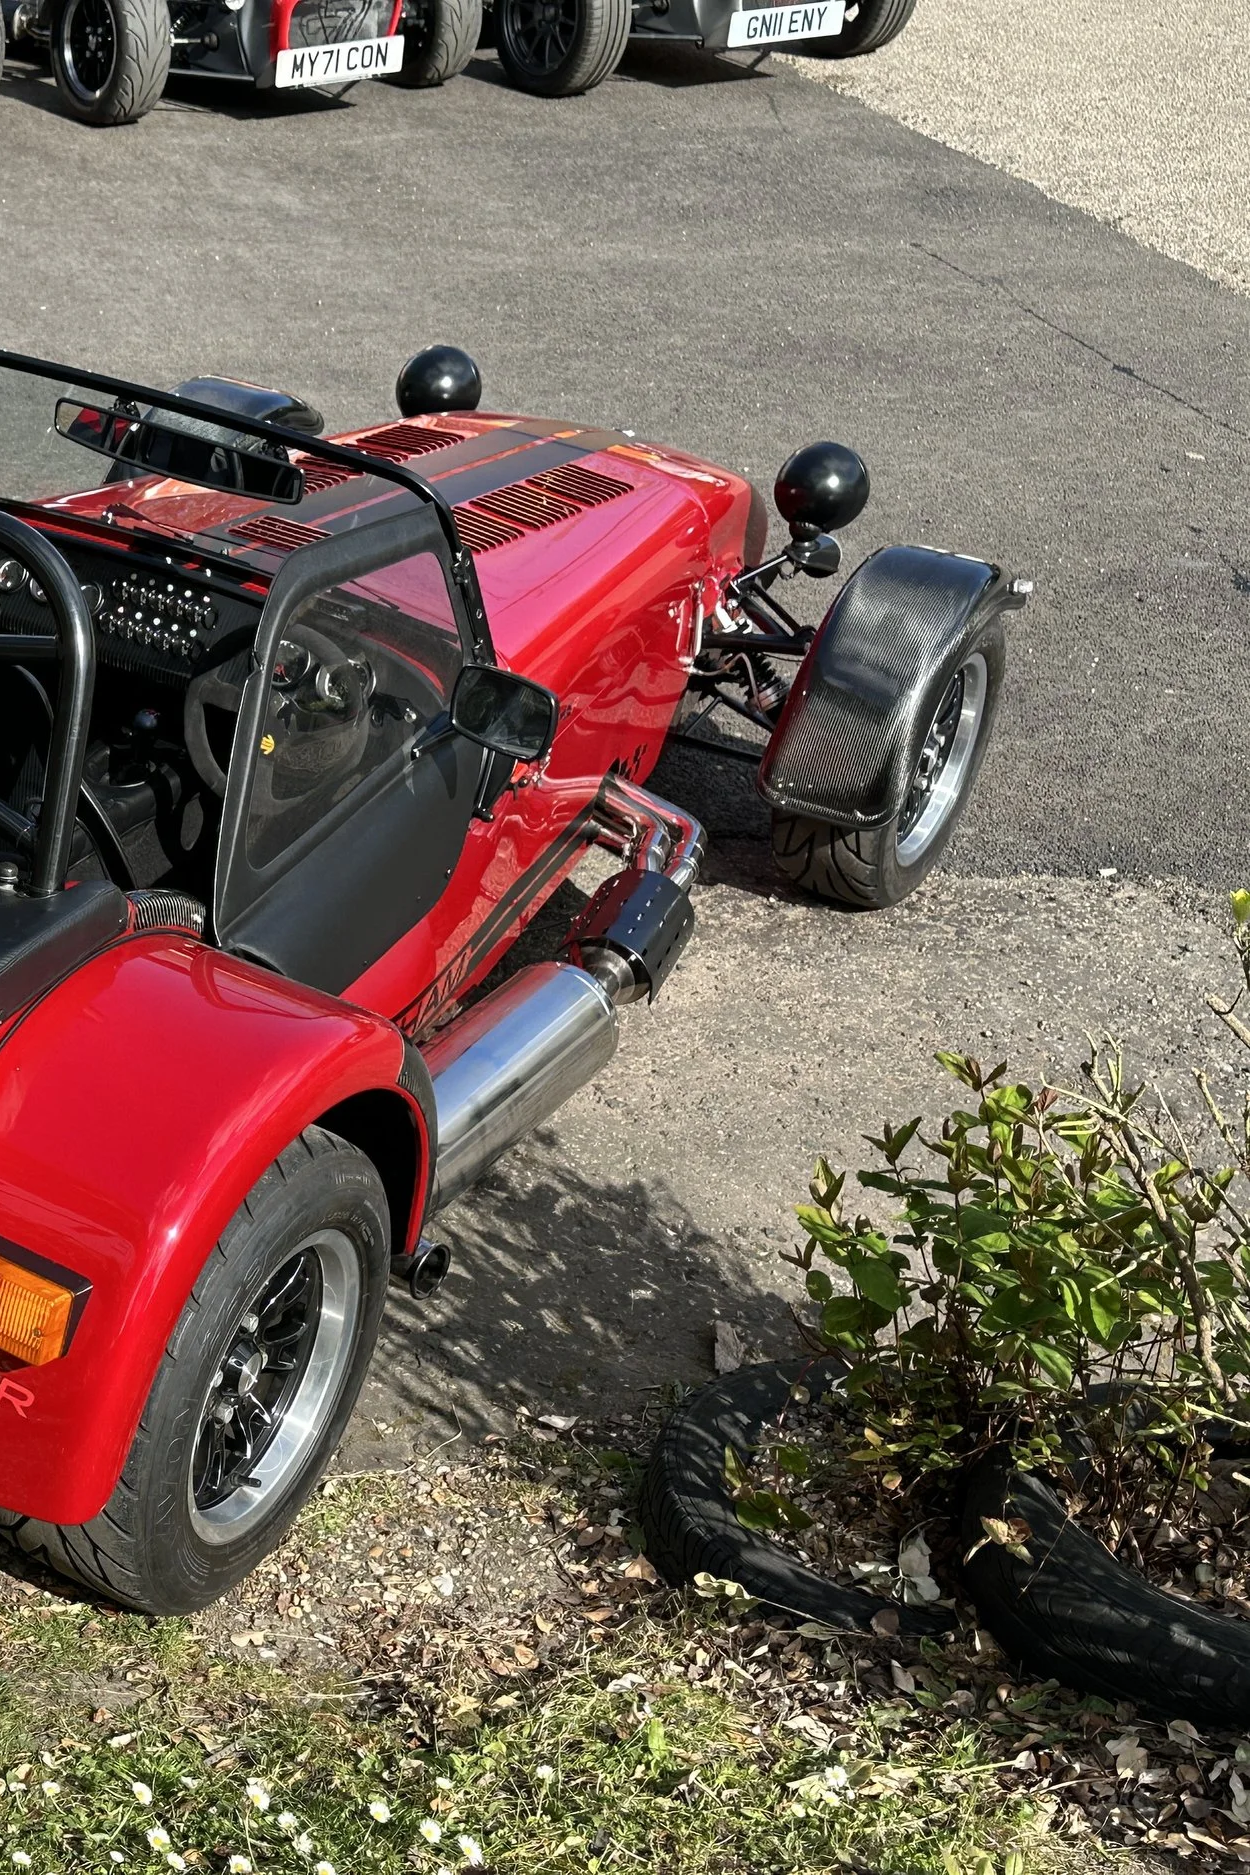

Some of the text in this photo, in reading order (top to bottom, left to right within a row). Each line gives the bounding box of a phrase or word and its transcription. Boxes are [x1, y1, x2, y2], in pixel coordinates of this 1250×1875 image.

[746, 6, 828, 40] GN11 ENY
[291, 42, 389, 79] MY71 CON
